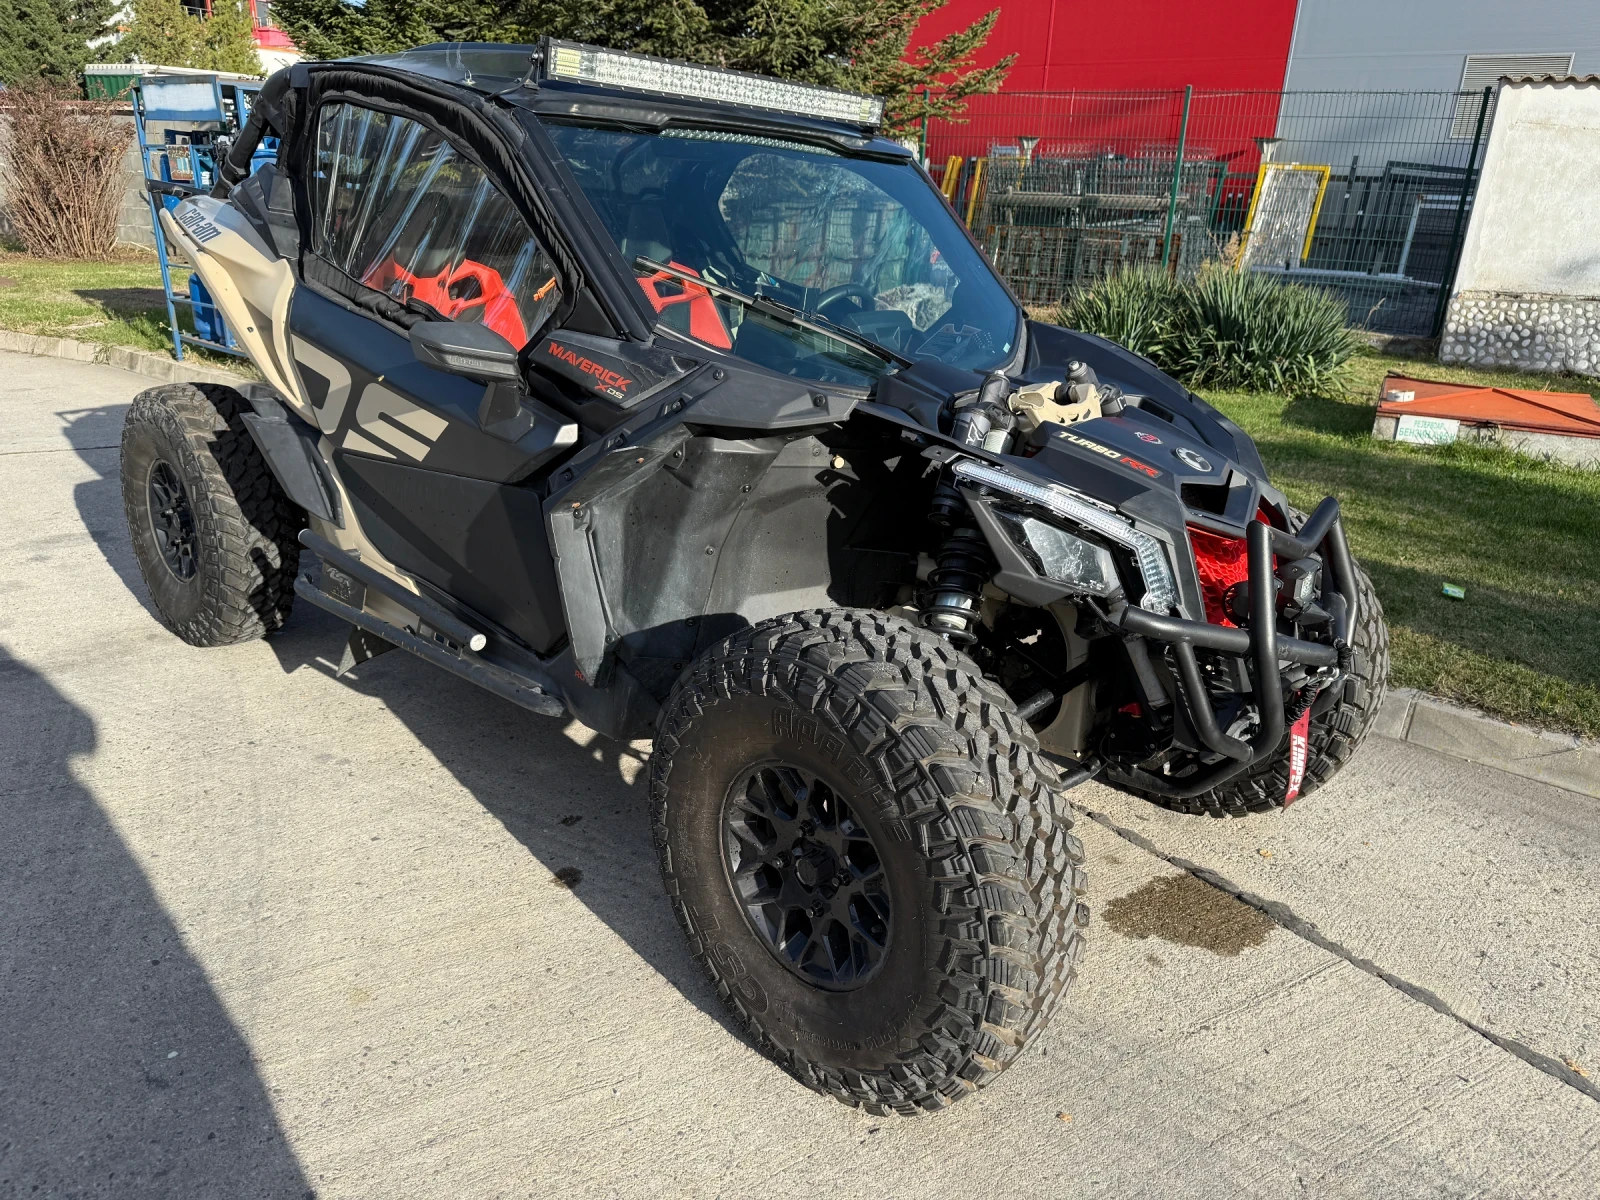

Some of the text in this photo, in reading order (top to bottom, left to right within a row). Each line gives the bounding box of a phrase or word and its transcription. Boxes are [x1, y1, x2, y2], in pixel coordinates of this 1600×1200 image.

[548, 341, 632, 392] MAVERICK
[1058, 431, 1159, 478] TURBO RR
[772, 704, 913, 842] APACHE
[1288, 733, 1306, 795] KIMPEX
[688, 904, 769, 1014] CST
